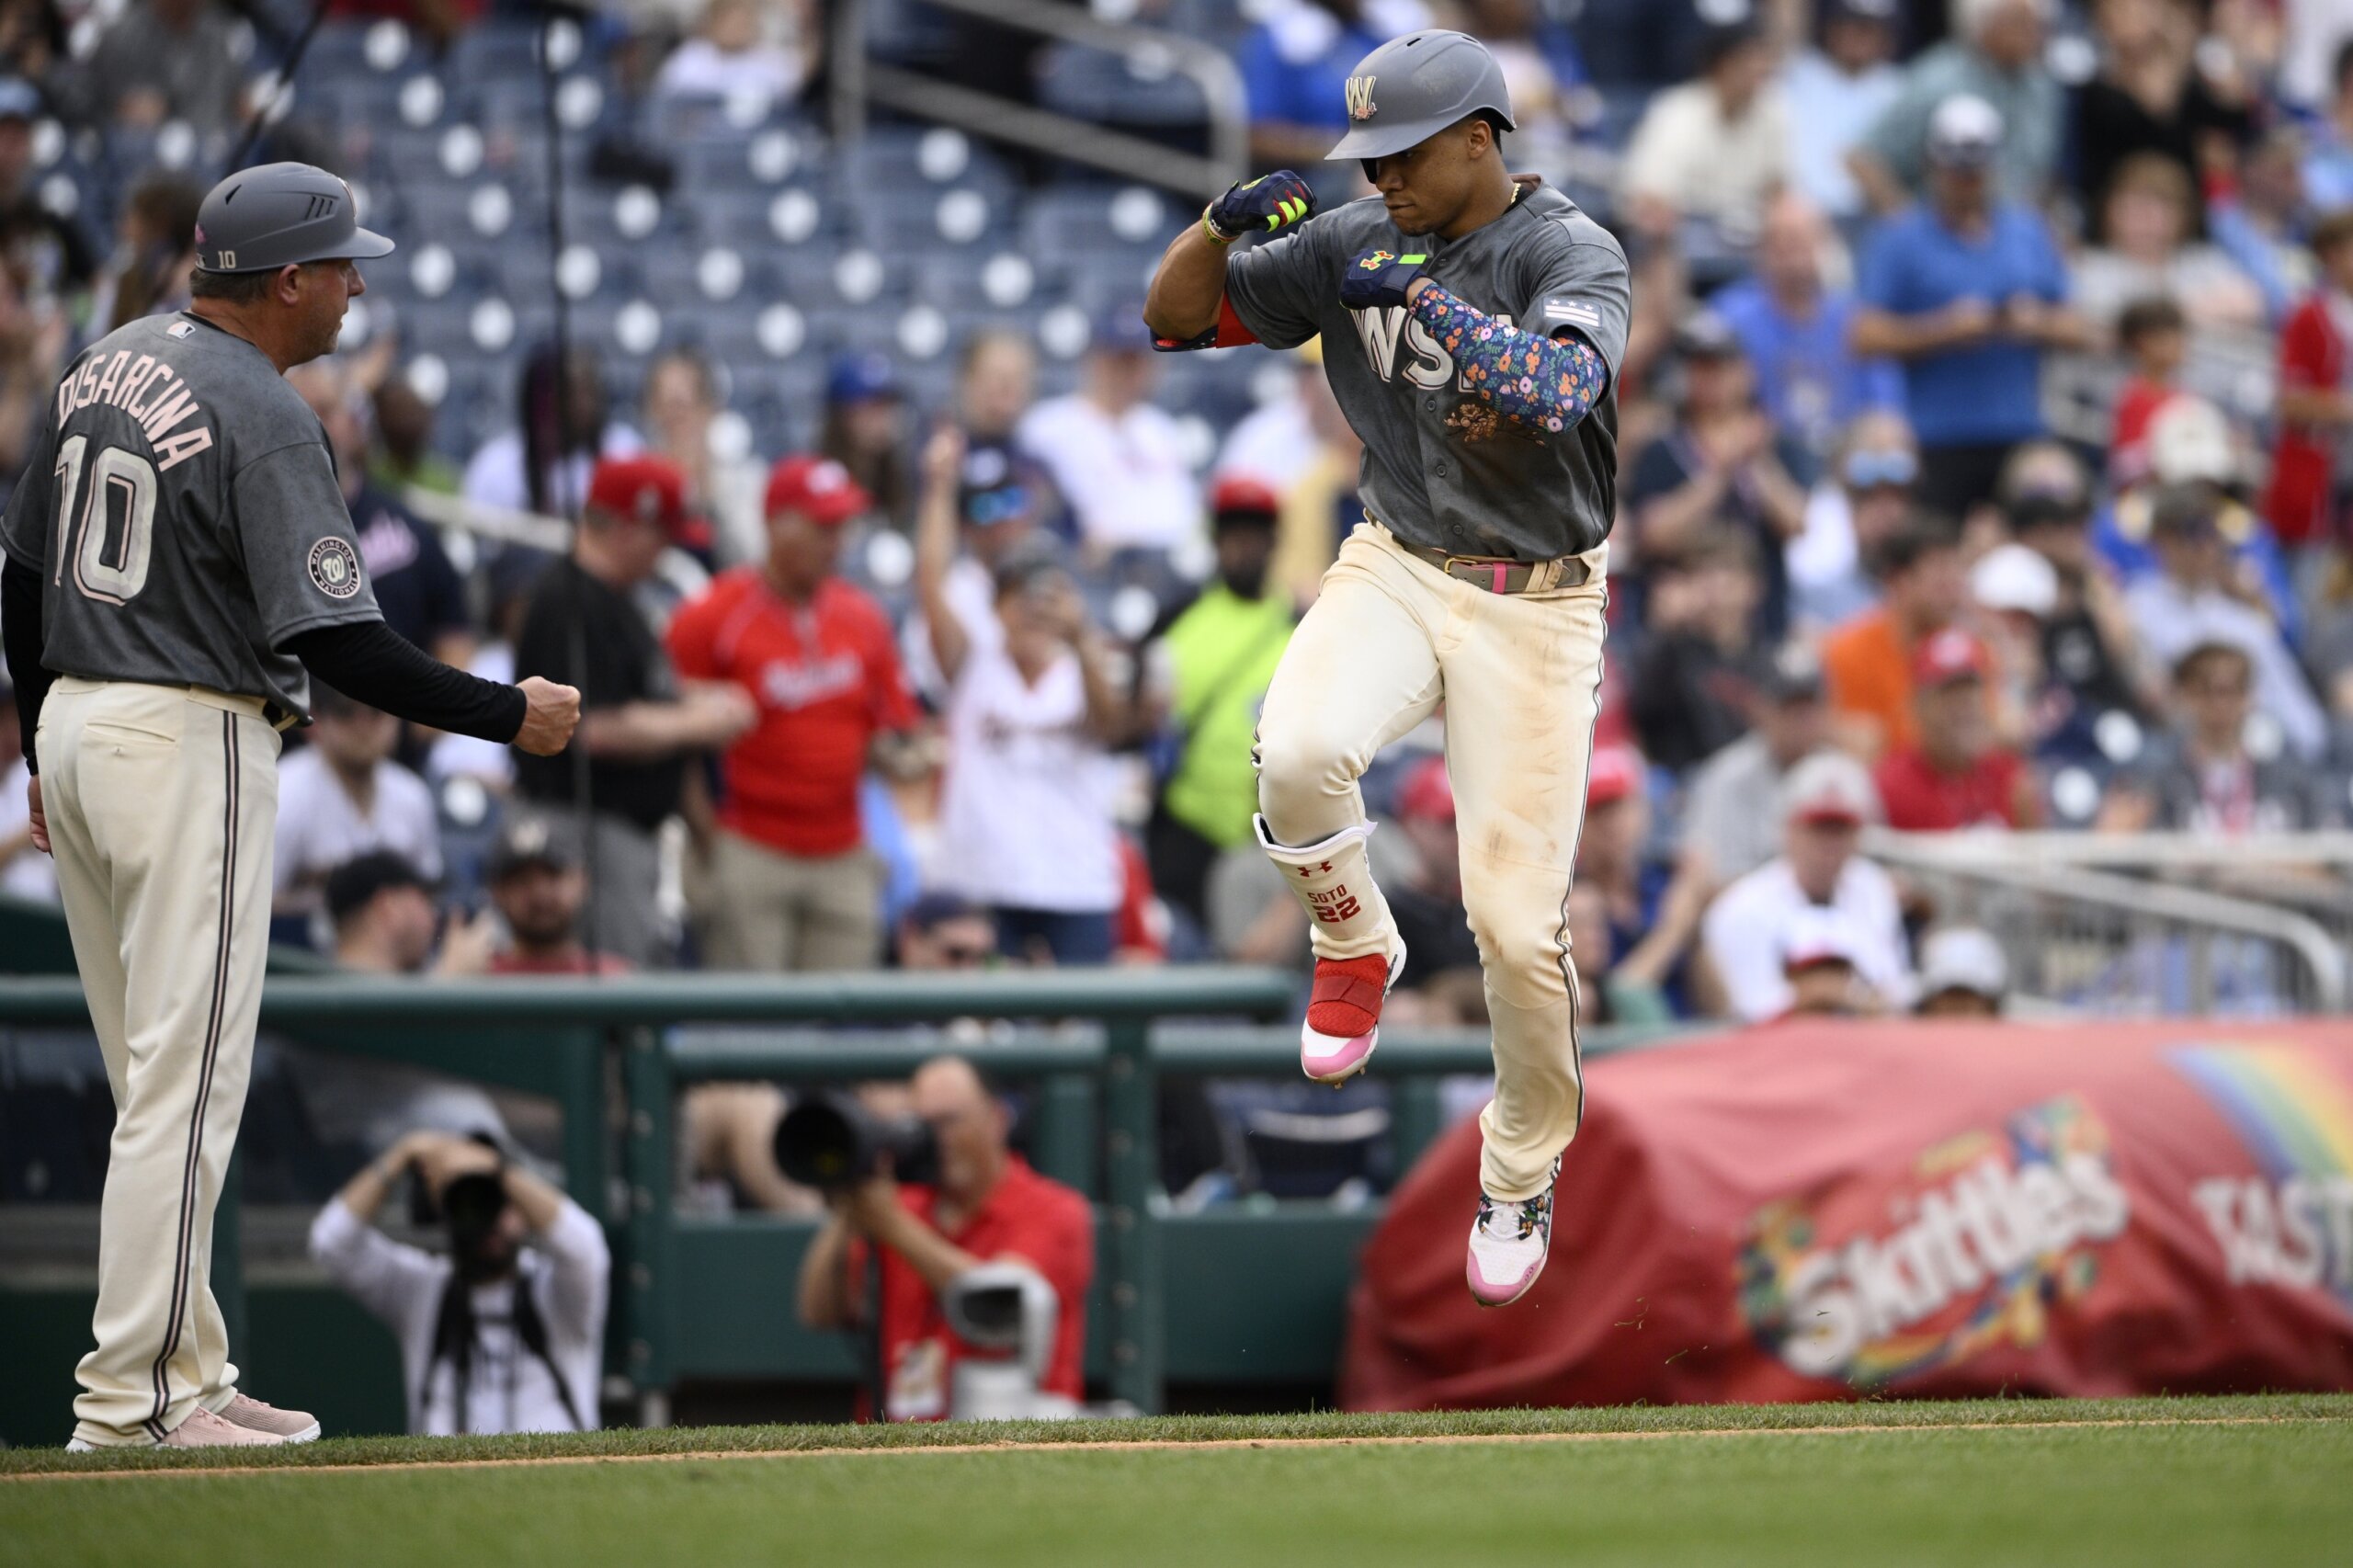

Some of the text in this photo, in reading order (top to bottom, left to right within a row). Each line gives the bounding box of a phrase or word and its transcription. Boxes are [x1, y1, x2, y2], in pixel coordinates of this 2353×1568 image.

[218, 250, 237, 269] 10
[58, 349, 213, 472] DISARCINA
[53, 434, 157, 607] 10
[312, 540, 353, 564] WASHINGTON
[1307, 883, 1347, 903] SOTO
[1312, 894, 1361, 923] 22
[1781, 1154, 2129, 1375] Skittles
